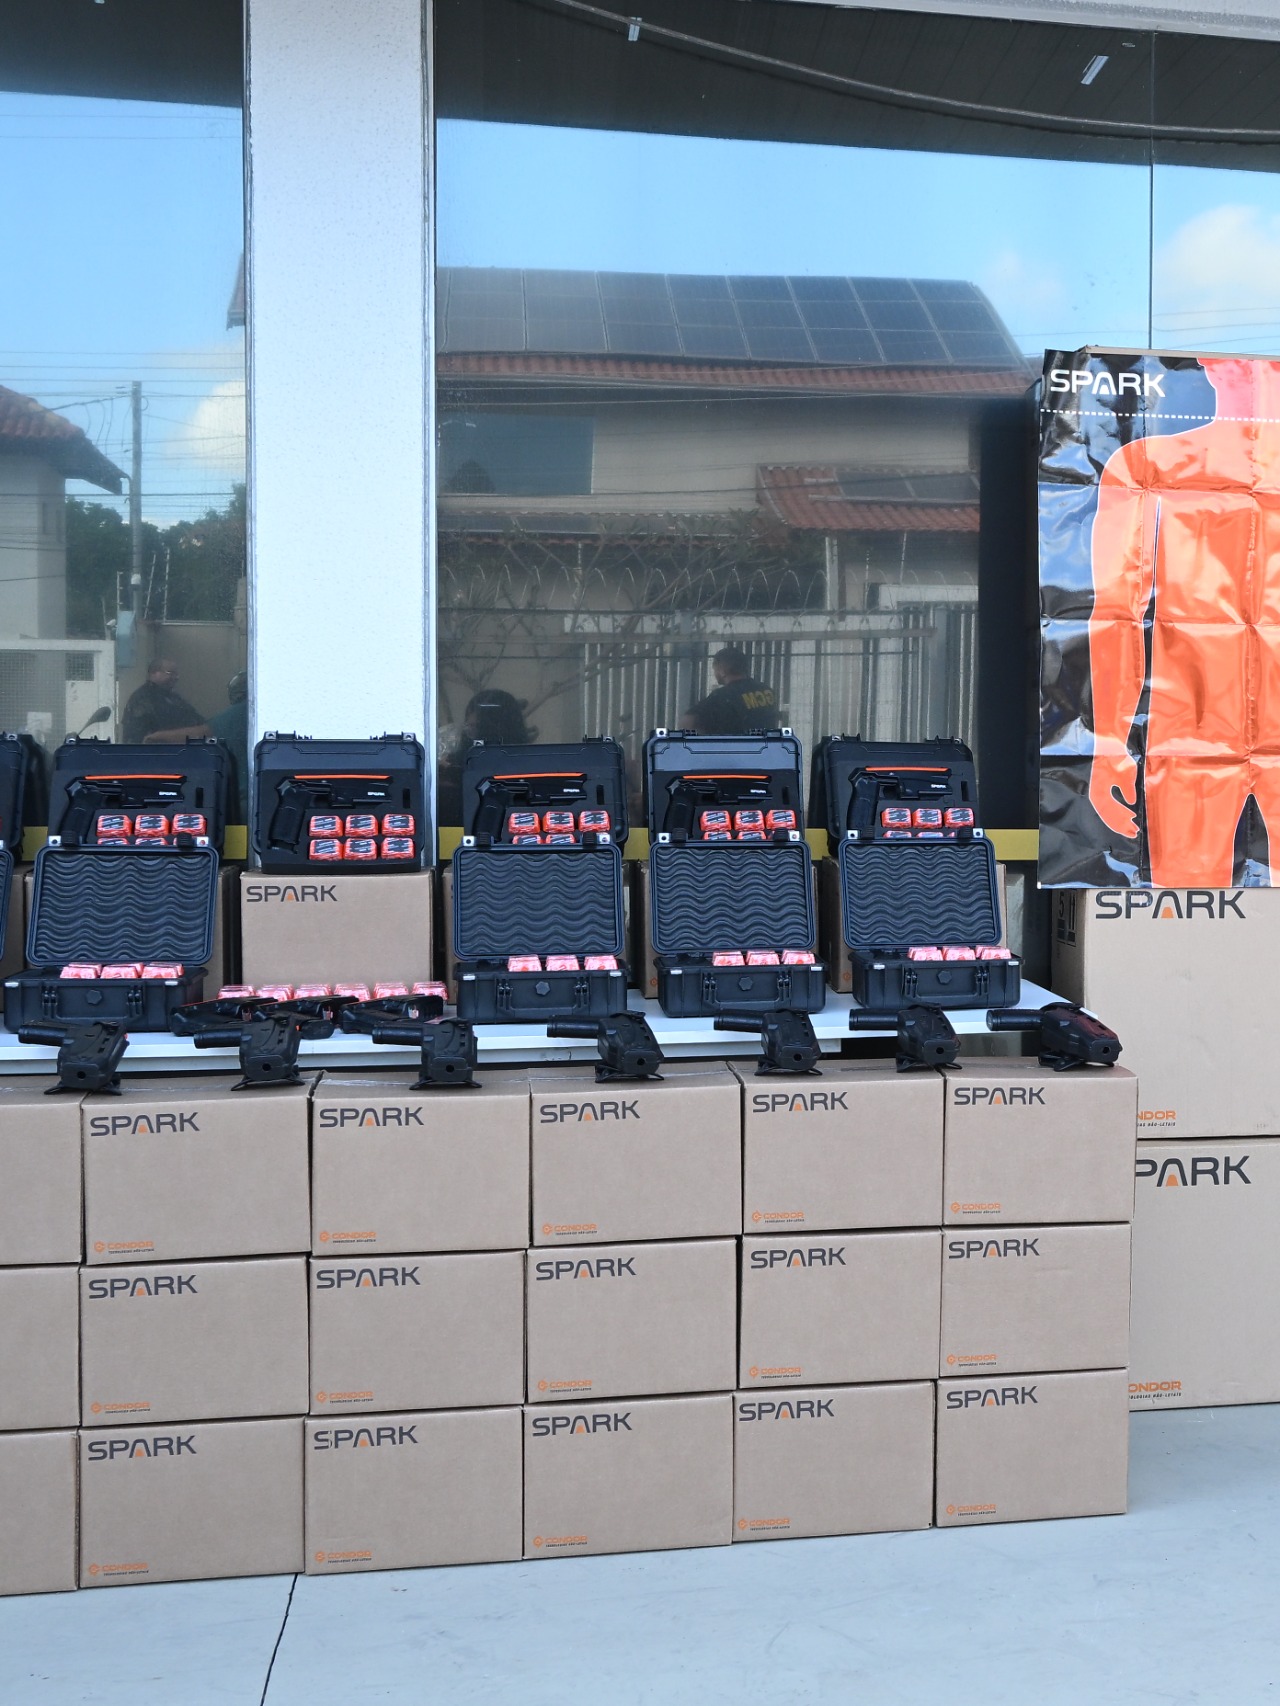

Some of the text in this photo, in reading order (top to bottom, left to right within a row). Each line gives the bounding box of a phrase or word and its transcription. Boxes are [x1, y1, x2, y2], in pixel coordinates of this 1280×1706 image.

[1050, 369, 1166, 397] SPARK
[247, 885, 338, 903] SPARK
[1096, 891, 1247, 919] SPARK
[752, 1091, 848, 1112] SPARK
[954, 1087, 1045, 1106] SPARK
[90, 1112, 200, 1136] SPARK
[319, 1107, 424, 1128] SPARK
[540, 1101, 640, 1124] SPARK
[1137, 1110, 1176, 1120] NDOR
[1136, 1156, 1251, 1187] PARK
[751, 1247, 846, 1268] SPARK
[948, 1238, 1040, 1259] SPARK
[316, 1266, 420, 1289] SPARK
[536, 1257, 636, 1280] SPARK
[89, 1275, 198, 1299] SPARK
[946, 1385, 1038, 1410] SPARK
[1128, 1381, 1182, 1393] ONDOR
[739, 1399, 834, 1422] SPARK
[532, 1413, 632, 1437] SPARK
[88, 1435, 196, 1461] SPARK
[314, 1425, 418, 1450] SPARK
